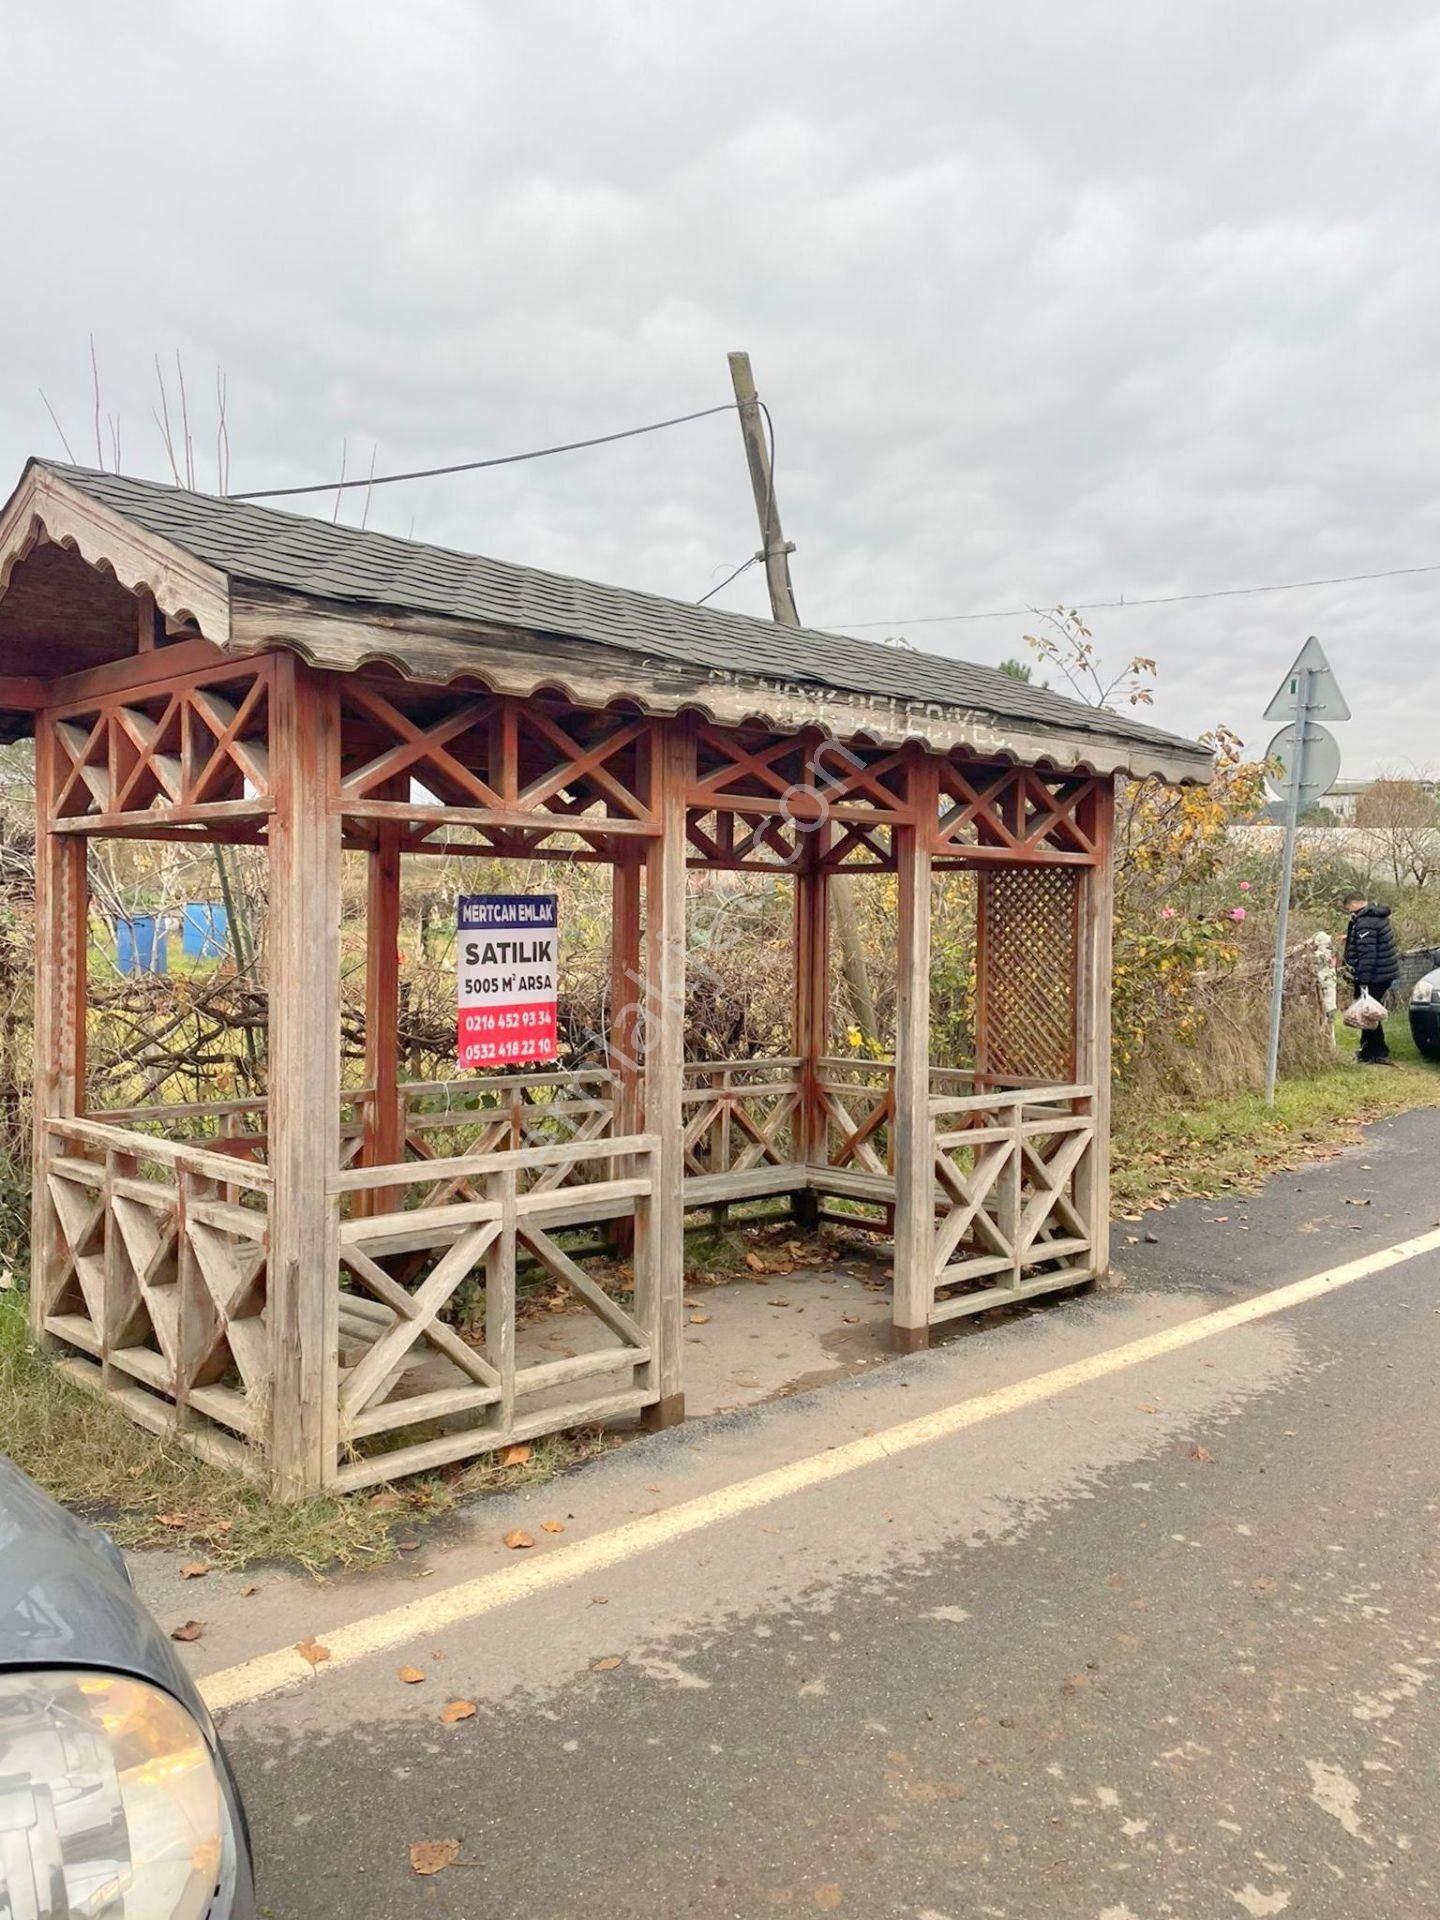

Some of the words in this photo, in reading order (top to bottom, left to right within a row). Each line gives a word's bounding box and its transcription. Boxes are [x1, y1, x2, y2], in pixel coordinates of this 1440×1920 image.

[462, 904, 517, 923] MERTCAN
[518, 904, 553, 921] EMLAK
[465, 941, 552, 966] SATILIK
[465, 978, 499, 994] 5005
[518, 975, 552, 991] ARSA
[465, 1016, 495, 1031] 0216
[498, 1013, 519, 1029] 452
[522, 1012, 536, 1026] 93
[538, 1010, 551, 1025] 34
[465, 1044, 496, 1060] 0532
[498, 1041, 518, 1057] 418
[521, 1040, 536, 1055] 22
[538, 1038, 551, 1053] 10
